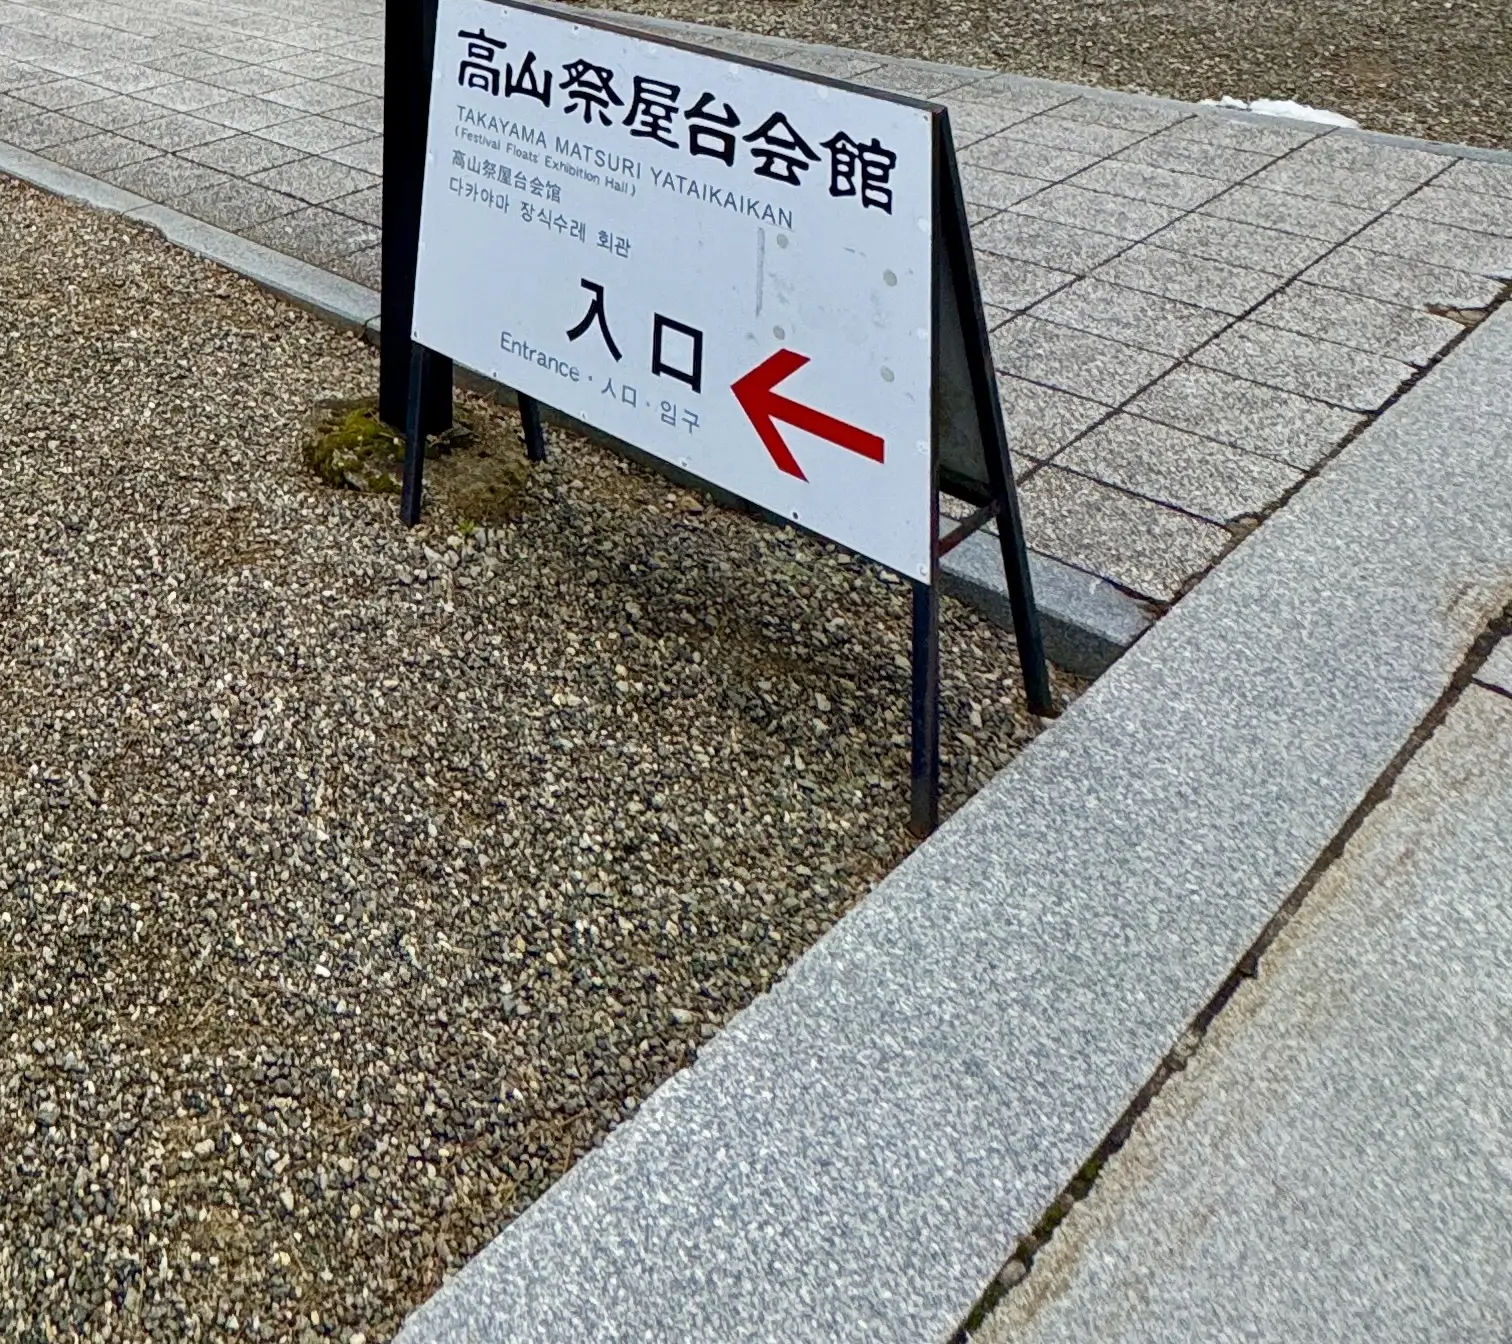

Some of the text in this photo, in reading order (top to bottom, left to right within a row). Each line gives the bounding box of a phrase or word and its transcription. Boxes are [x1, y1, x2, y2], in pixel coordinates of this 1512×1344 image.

[455, 125, 501, 150] (Festival
[544, 155, 600, 184] Exhibition
[456, 105, 793, 229] TAKAYAMA MATSURI YATAIKAIKAN
[457, 28, 898, 215] 高山祭屋台会館
[449, 176, 631, 258] 다카야마 장식수레 회관
[500, 331, 580, 383] Entrance
[660, 400, 700, 434] 입구
[565, 277, 704, 395] 入口
